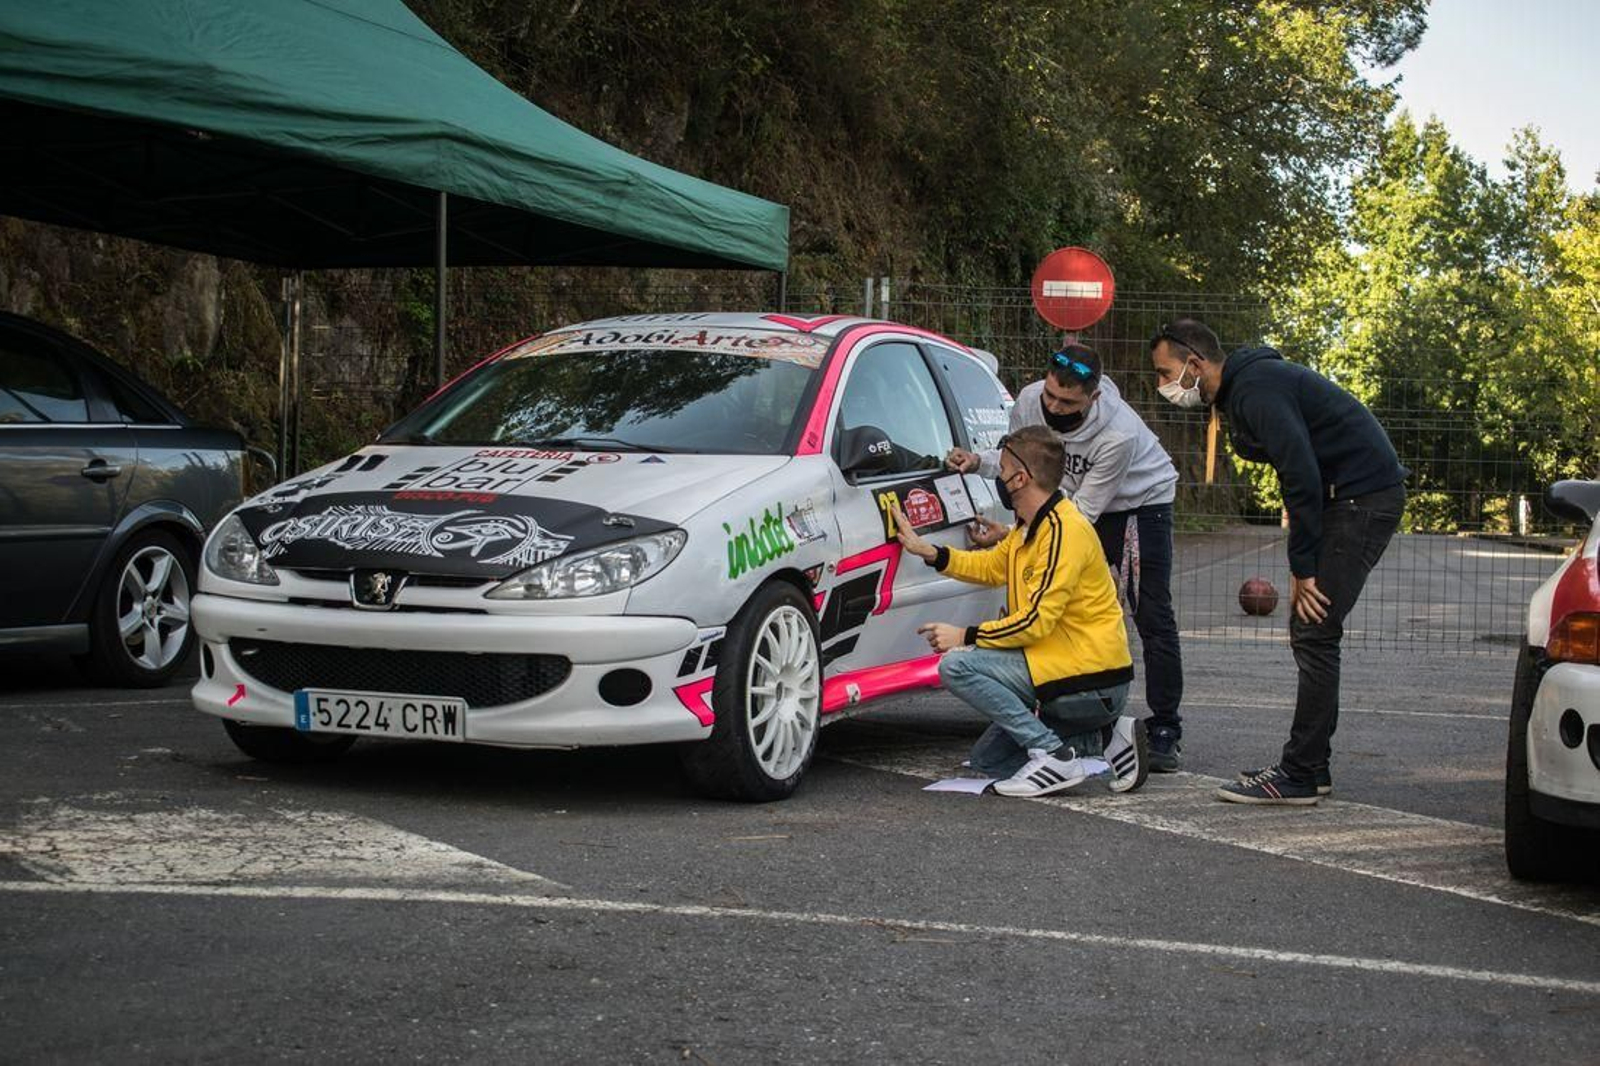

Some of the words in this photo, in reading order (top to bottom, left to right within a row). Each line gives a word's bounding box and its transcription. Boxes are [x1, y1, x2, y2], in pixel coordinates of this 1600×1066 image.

[474, 450, 575, 462] CAFETERIA
[454, 458, 541, 475] blu
[420, 470, 523, 491] bar
[260, 514, 404, 545] OSIRIS
[301, 714, 308, 724] E
[316, 697, 390, 731] 5224
[401, 702, 457, 736] CRW
